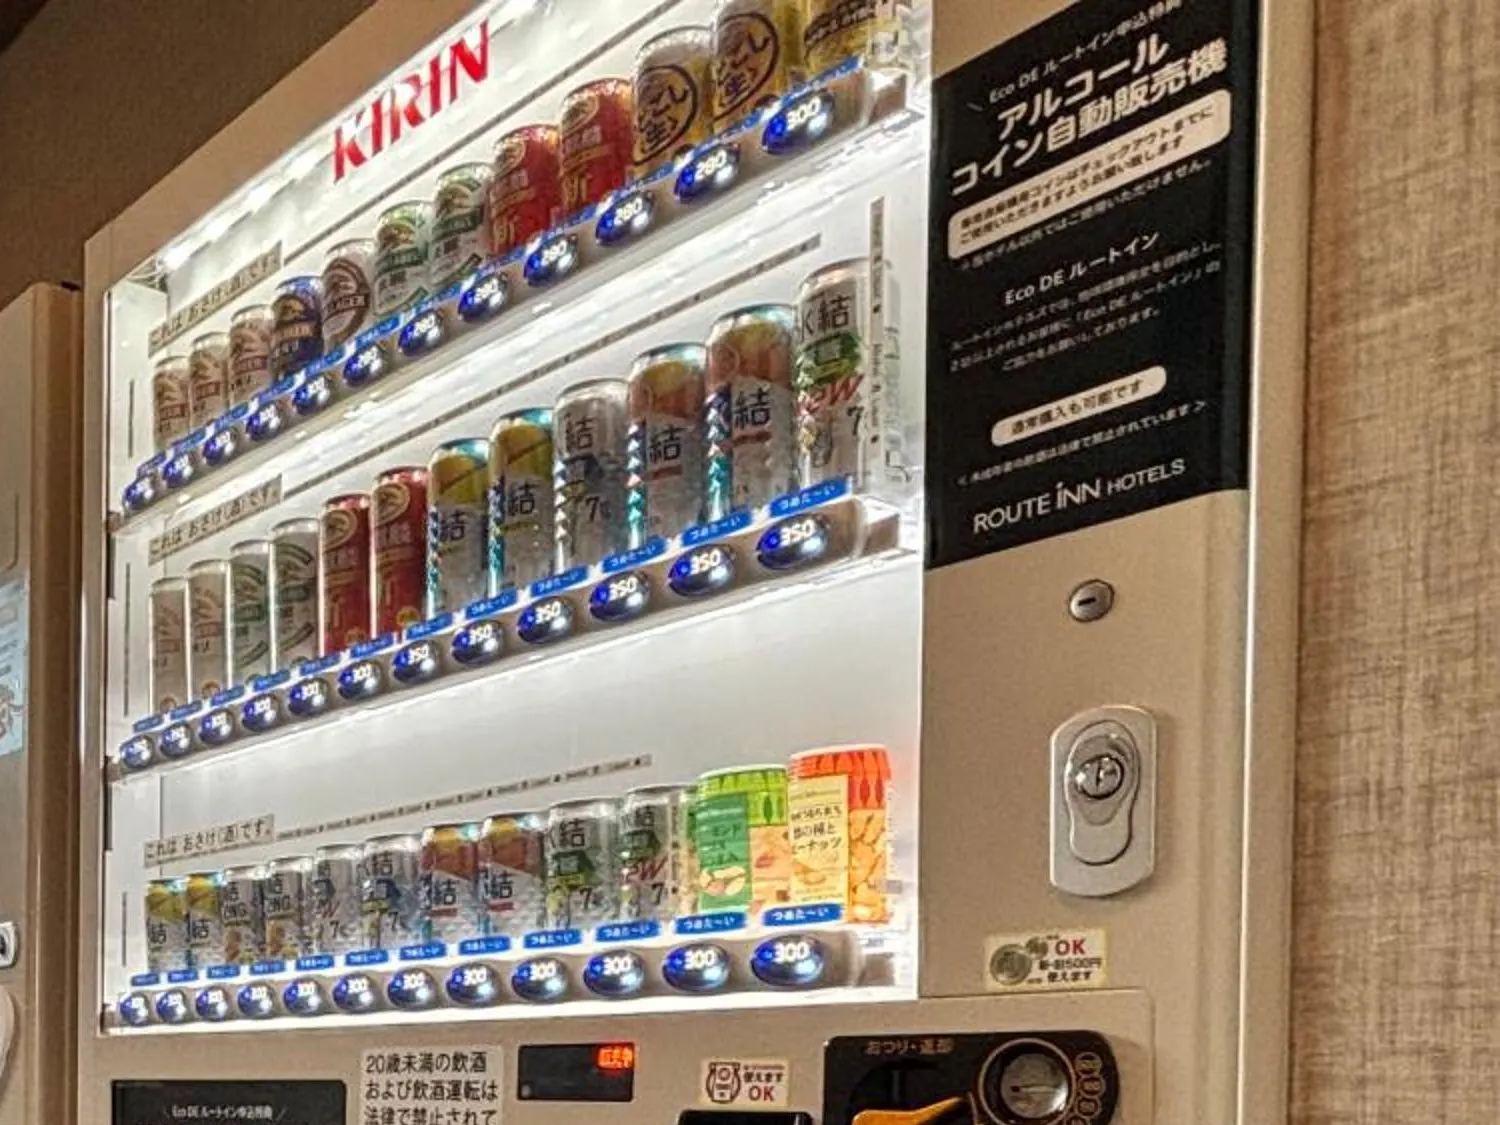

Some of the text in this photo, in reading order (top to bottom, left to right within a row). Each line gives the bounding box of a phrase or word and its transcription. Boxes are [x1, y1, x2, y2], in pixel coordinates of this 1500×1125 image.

[997, 32, 1170, 140] アルコール
[334, 18, 489, 185] KIRIN
[786, 96, 822, 128] 300
[951, 36, 1228, 196] コイン自動販売機
[1004, 231, 1160, 306] Eco DE ルートイン
[733, 387, 771, 428] 結
[649, 425, 685, 461] 結
[507, 480, 538, 517] 結
[780, 485, 838, 510] つめた～い
[973, 495, 1051, 534] ROUTE
[1107, 457, 1187, 497] HOTELS
[779, 519, 816, 542] 350
[690, 550, 722, 574] 350
[607, 579, 638, 601] 350
[683, 916, 735, 930] つめた～い
[772, 906, 830, 921] つめた～い
[772, 943, 811, 962] 300
[1054, 938, 1086, 956] OK
[530, 962, 557, 980] 300
[603, 956, 632, 975] 300
[683, 950, 717, 970] 300
[463, 967, 488, 985] 300
[365, 1050, 488, 1074] 20歳未満の飲酒
[365, 1078, 498, 1102] および飲酒運転は
[748, 1085, 775, 1102] OK
